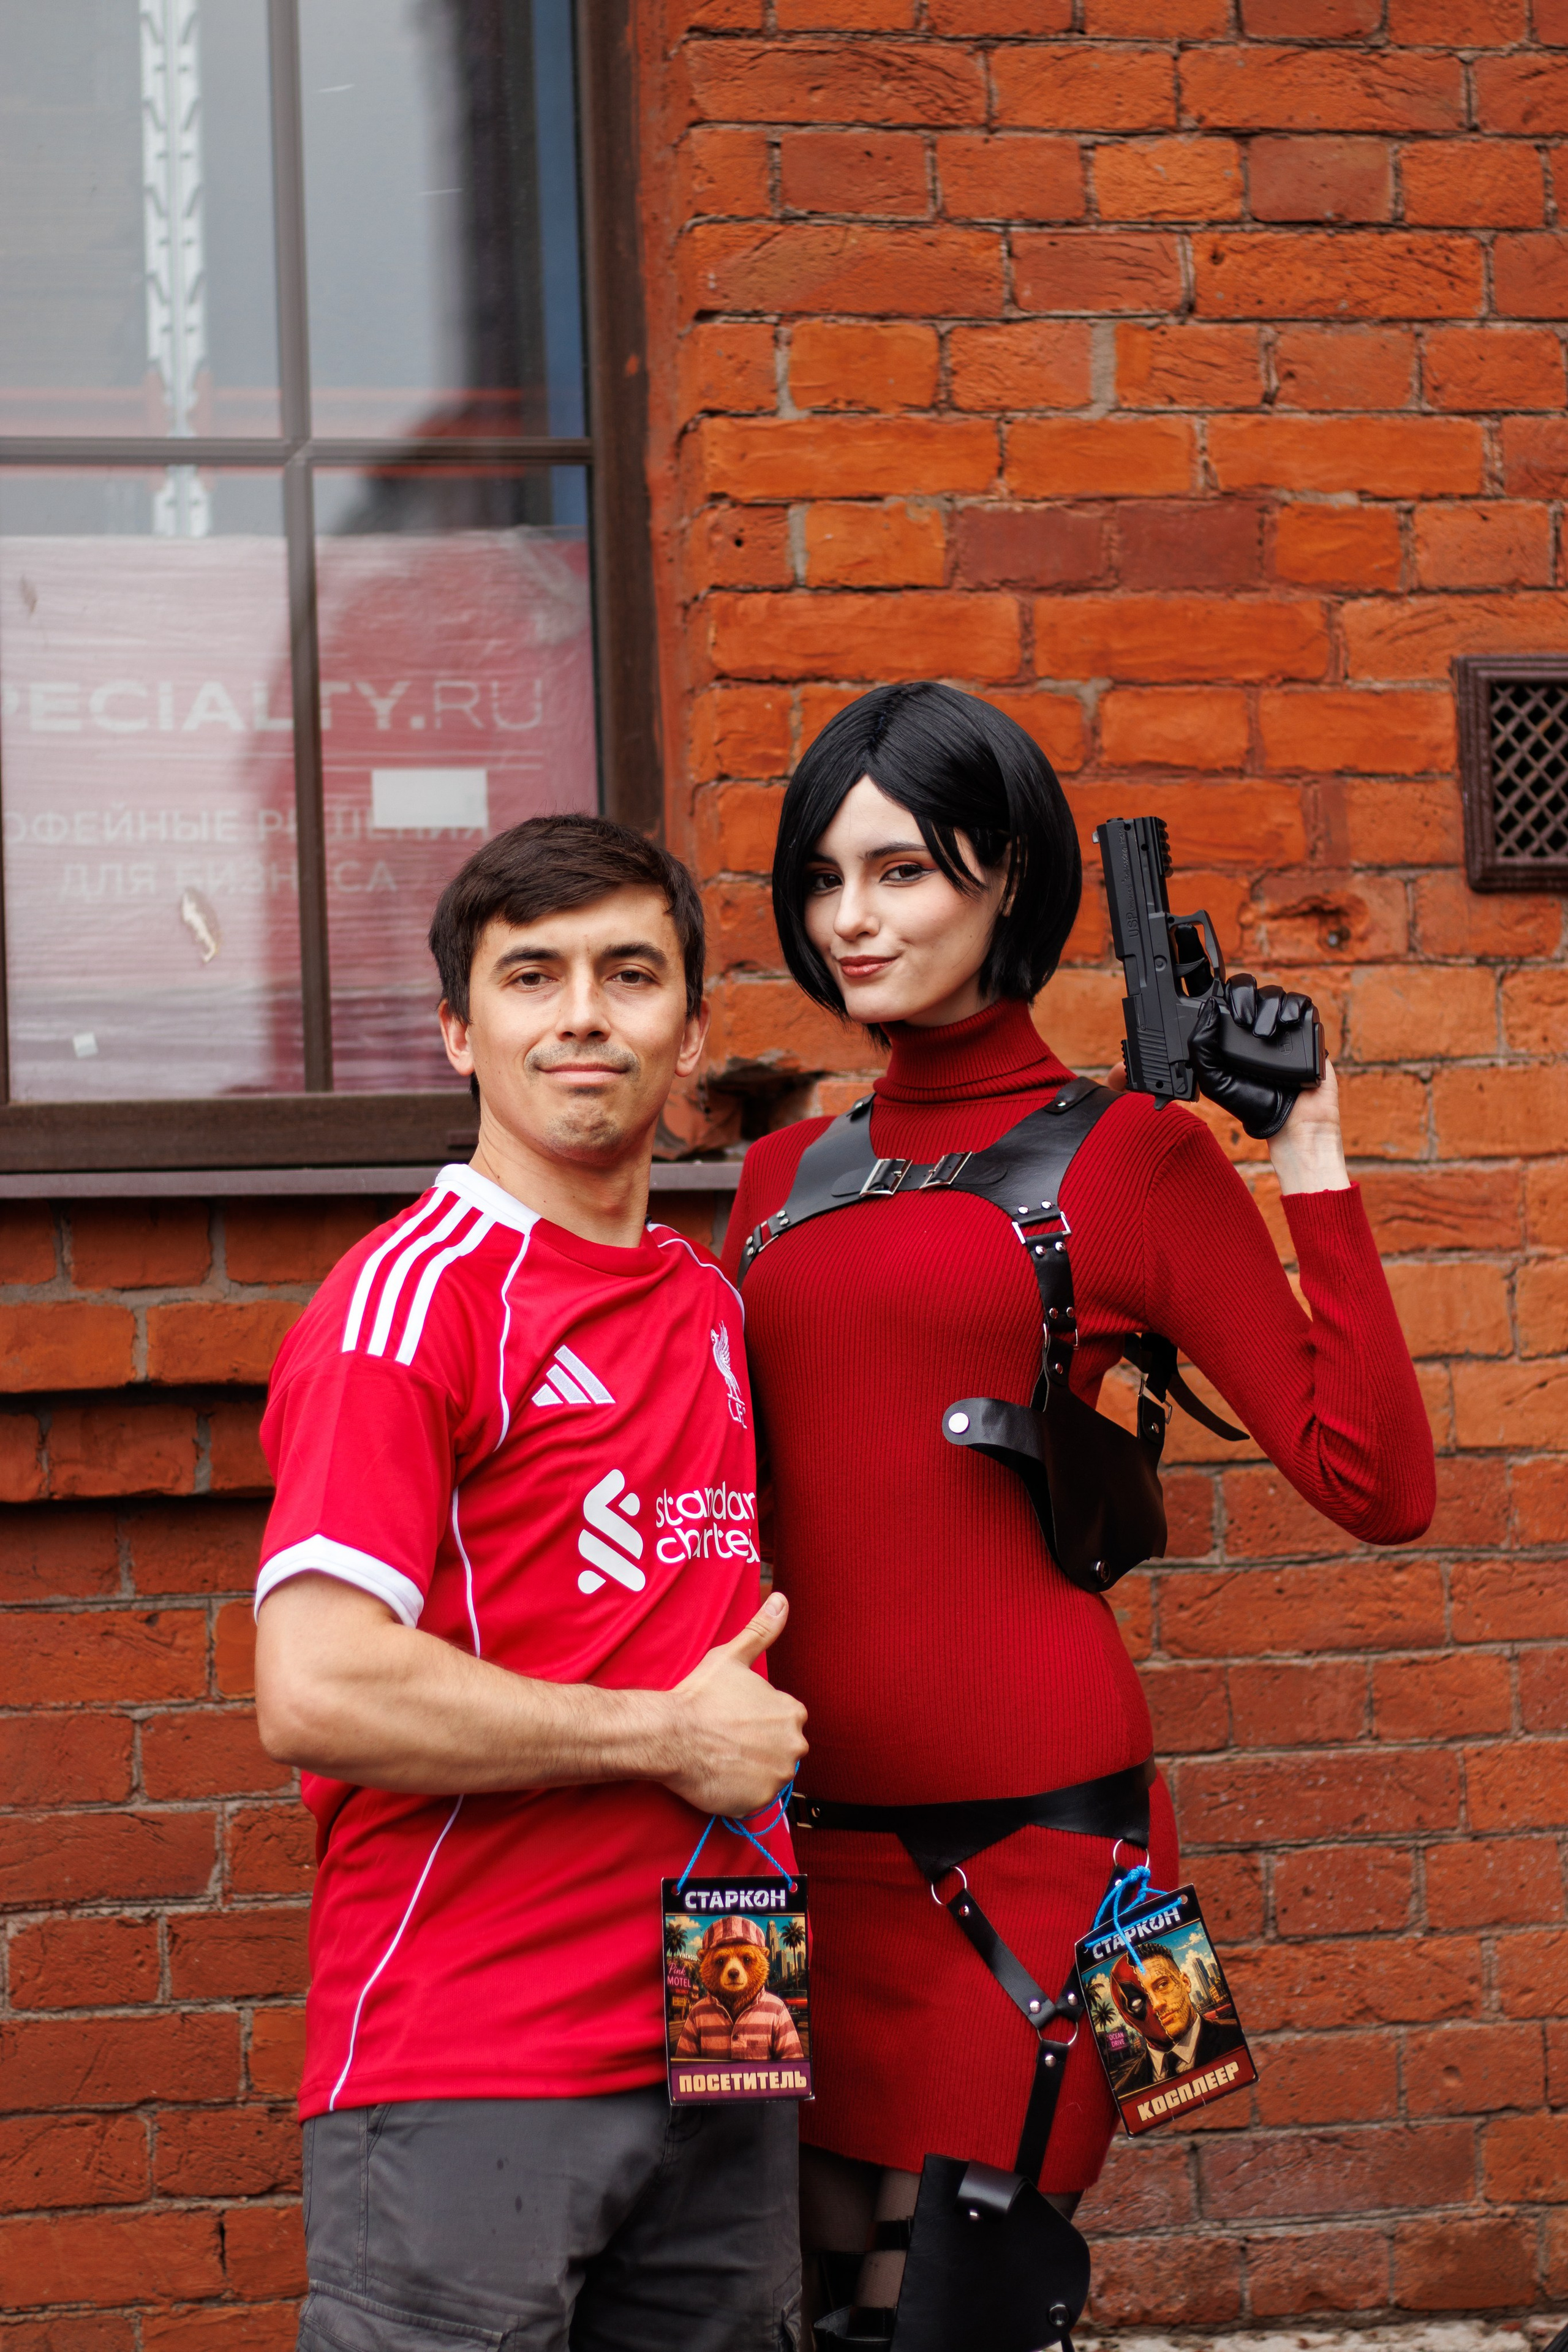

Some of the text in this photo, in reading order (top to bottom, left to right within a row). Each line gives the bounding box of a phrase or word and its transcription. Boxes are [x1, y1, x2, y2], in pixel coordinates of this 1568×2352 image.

[63, 859, 398, 902] ДЛЯ БИЗНСА
[1126, 911, 1140, 938] USP
[655, 1480, 756, 1528] standar
[685, 1889, 786, 1909] СТАРКОН
[1092, 1907, 1181, 1959] СТАРКОН
[669, 1962, 686, 1976] Pink
[667, 1975, 692, 1988] MOTEL
[1109, 2032, 1125, 2041] OCEAN
[1111, 2038, 1125, 2048] DRIVE
[679, 2071, 807, 2092] ПОСЕТИТЕЛЬ
[1137, 2061, 1240, 2122] КОСПЛЕЕР
